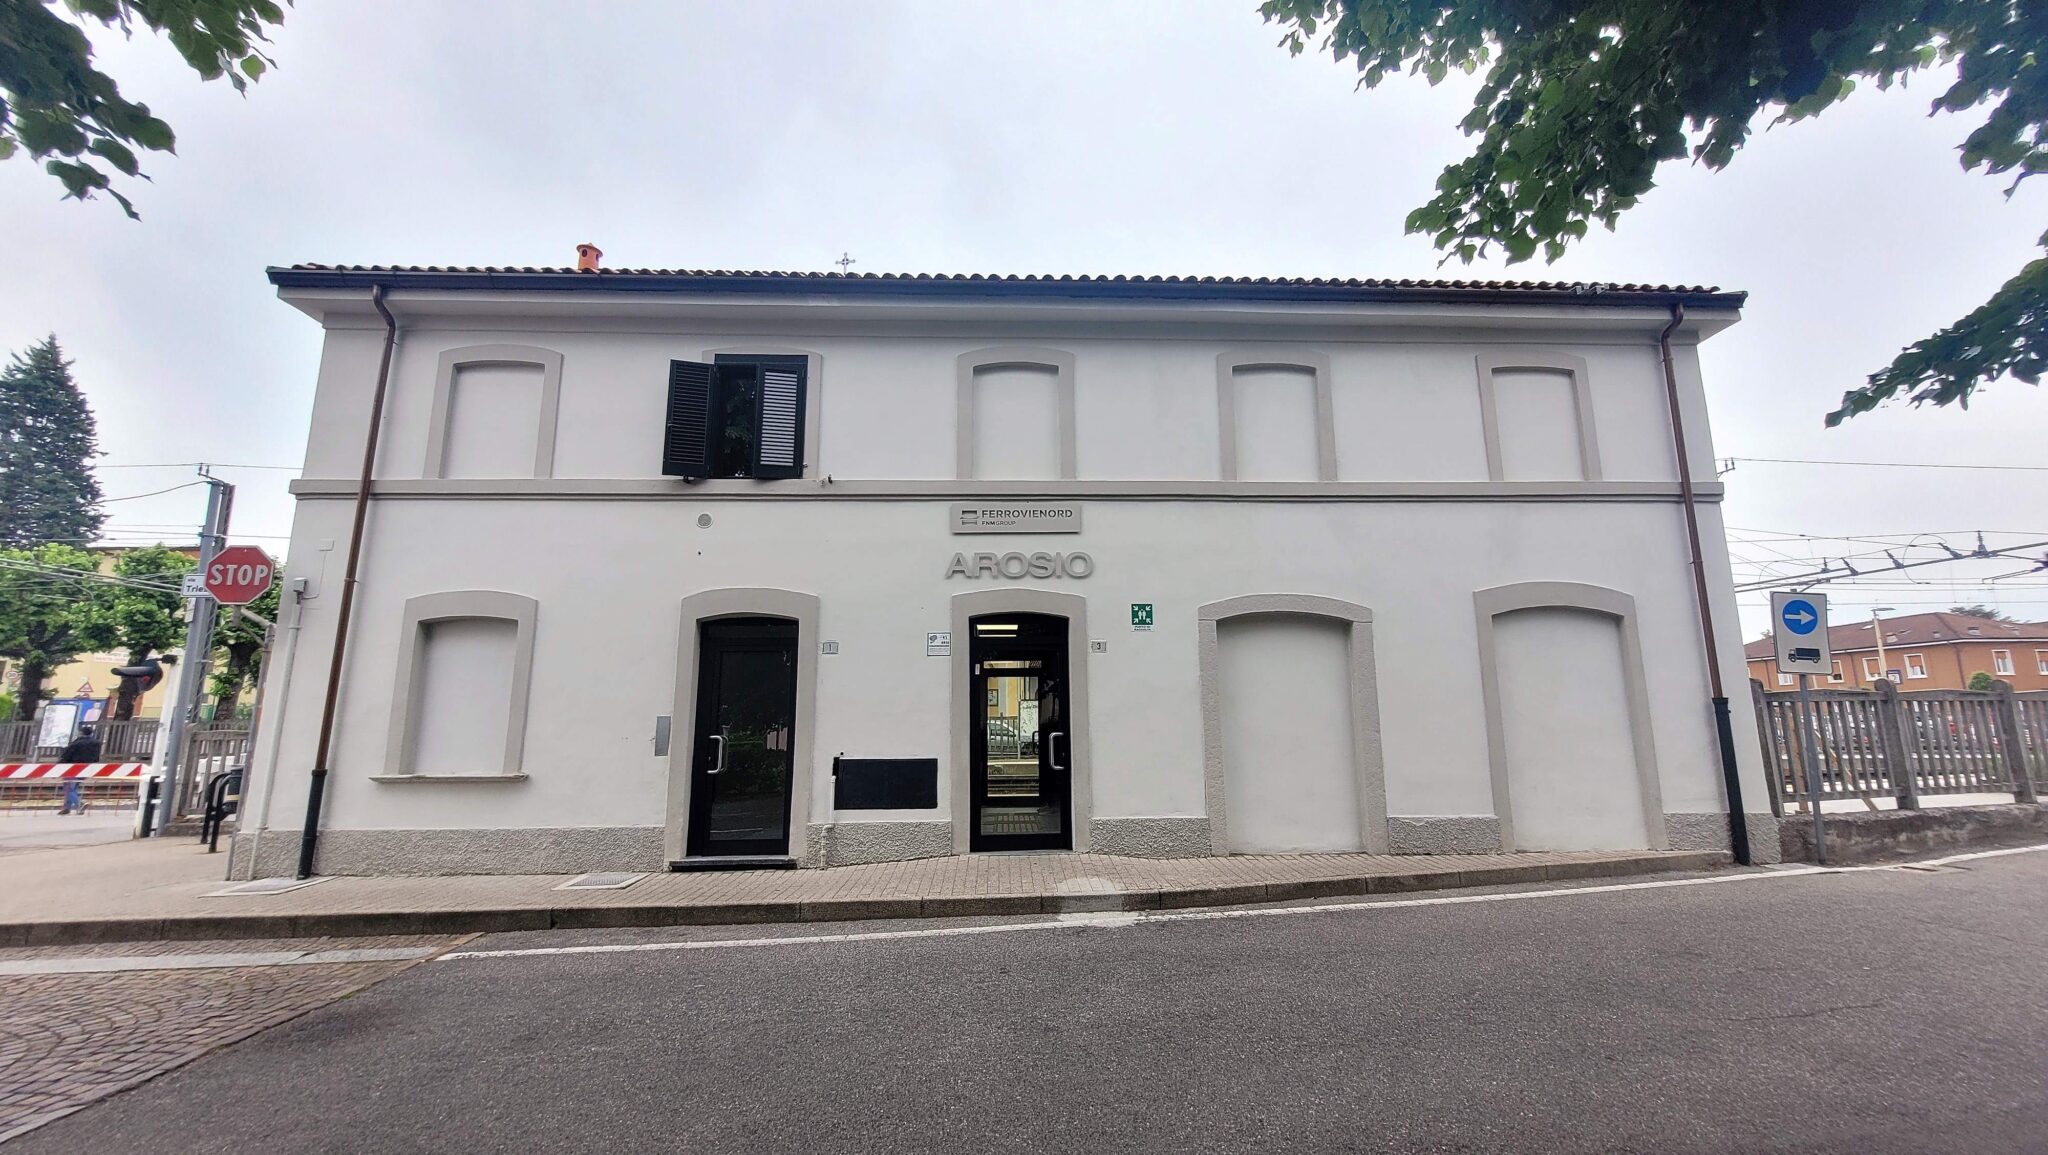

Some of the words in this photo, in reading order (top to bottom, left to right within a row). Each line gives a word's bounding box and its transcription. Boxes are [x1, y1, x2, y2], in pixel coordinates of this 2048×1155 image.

[981, 509, 1073, 519] FERROVIENORD
[945, 551, 1094, 578] AROSIO
[209, 564, 269, 586] STOP
[1096, 642, 1101, 650] 3
